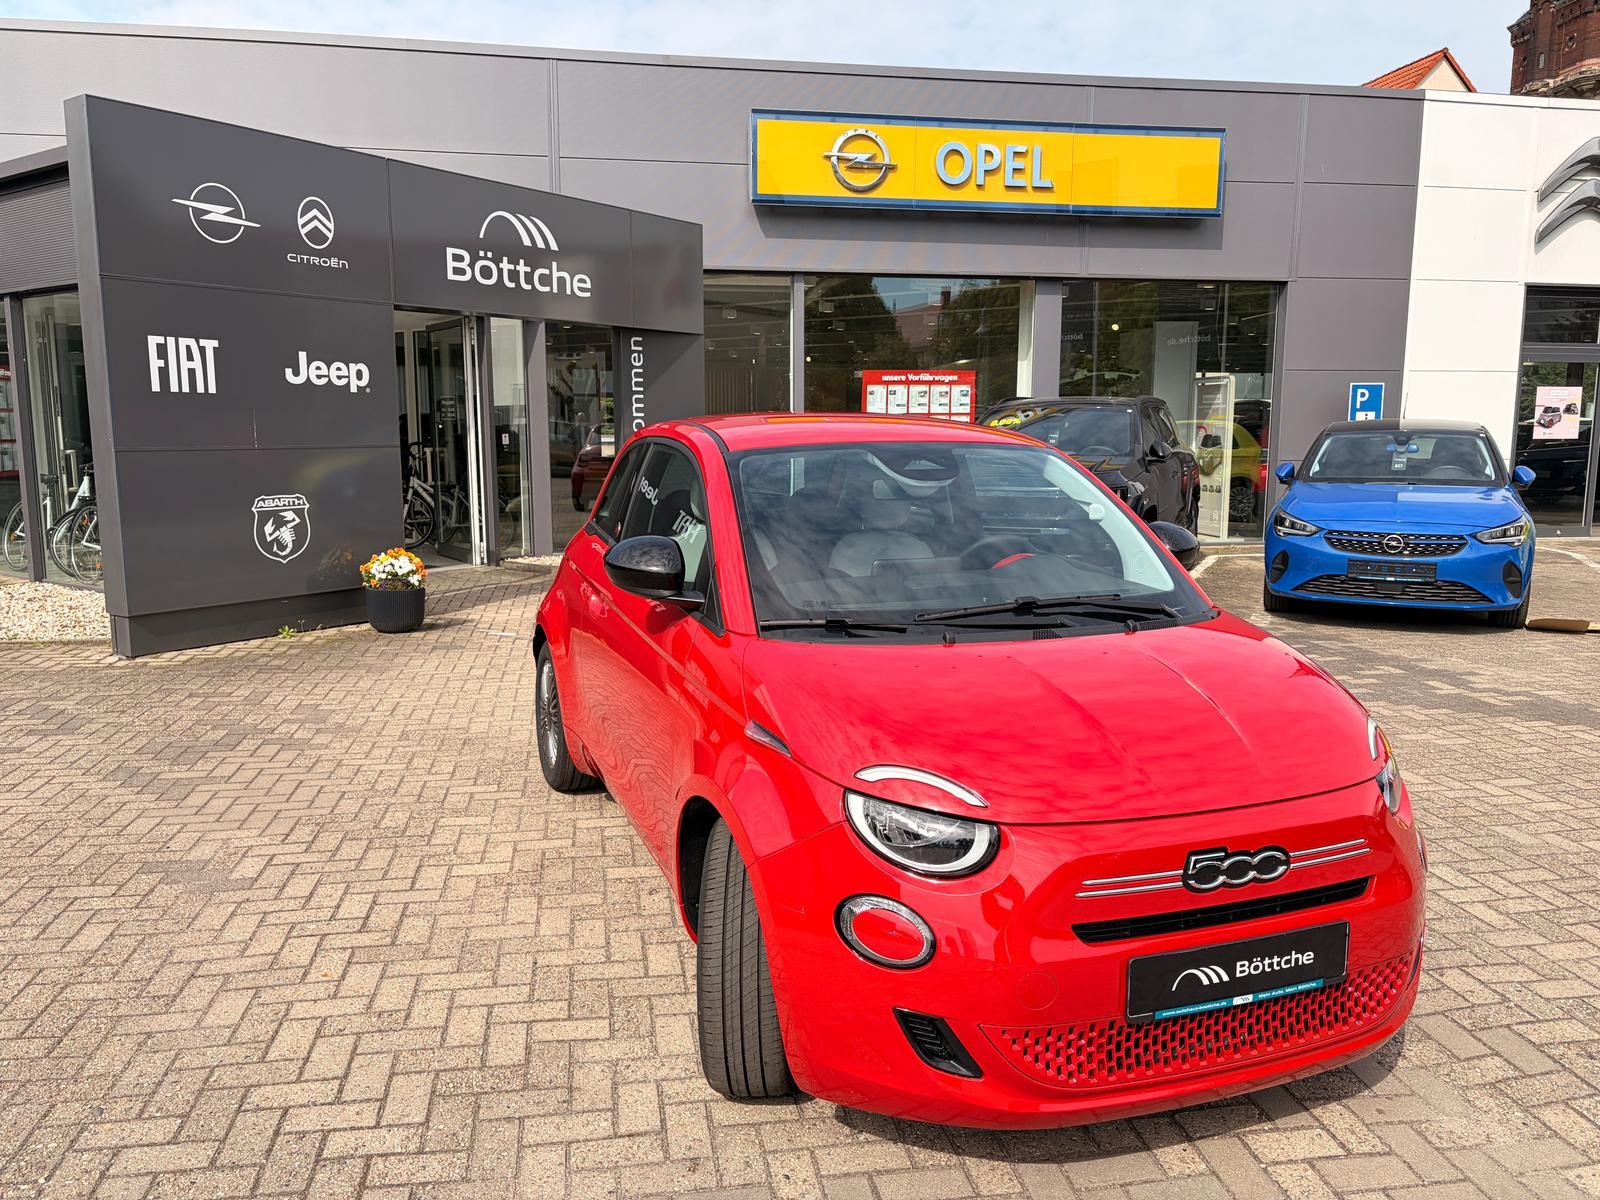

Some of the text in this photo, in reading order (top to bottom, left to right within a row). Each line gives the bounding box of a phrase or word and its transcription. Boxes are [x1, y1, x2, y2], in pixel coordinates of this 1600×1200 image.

[935, 140, 1055, 190] OPEL
[445, 246, 592, 298] Böttche
[147, 335, 219, 394] FIAT
[285, 351, 370, 393] Jeep
[881, 374, 906, 382] unsere
[1356, 388, 1370, 409] P
[256, 498, 304, 508] ABARTH
[1184, 847, 1290, 892] 500
[1235, 950, 1315, 978] Böttche
